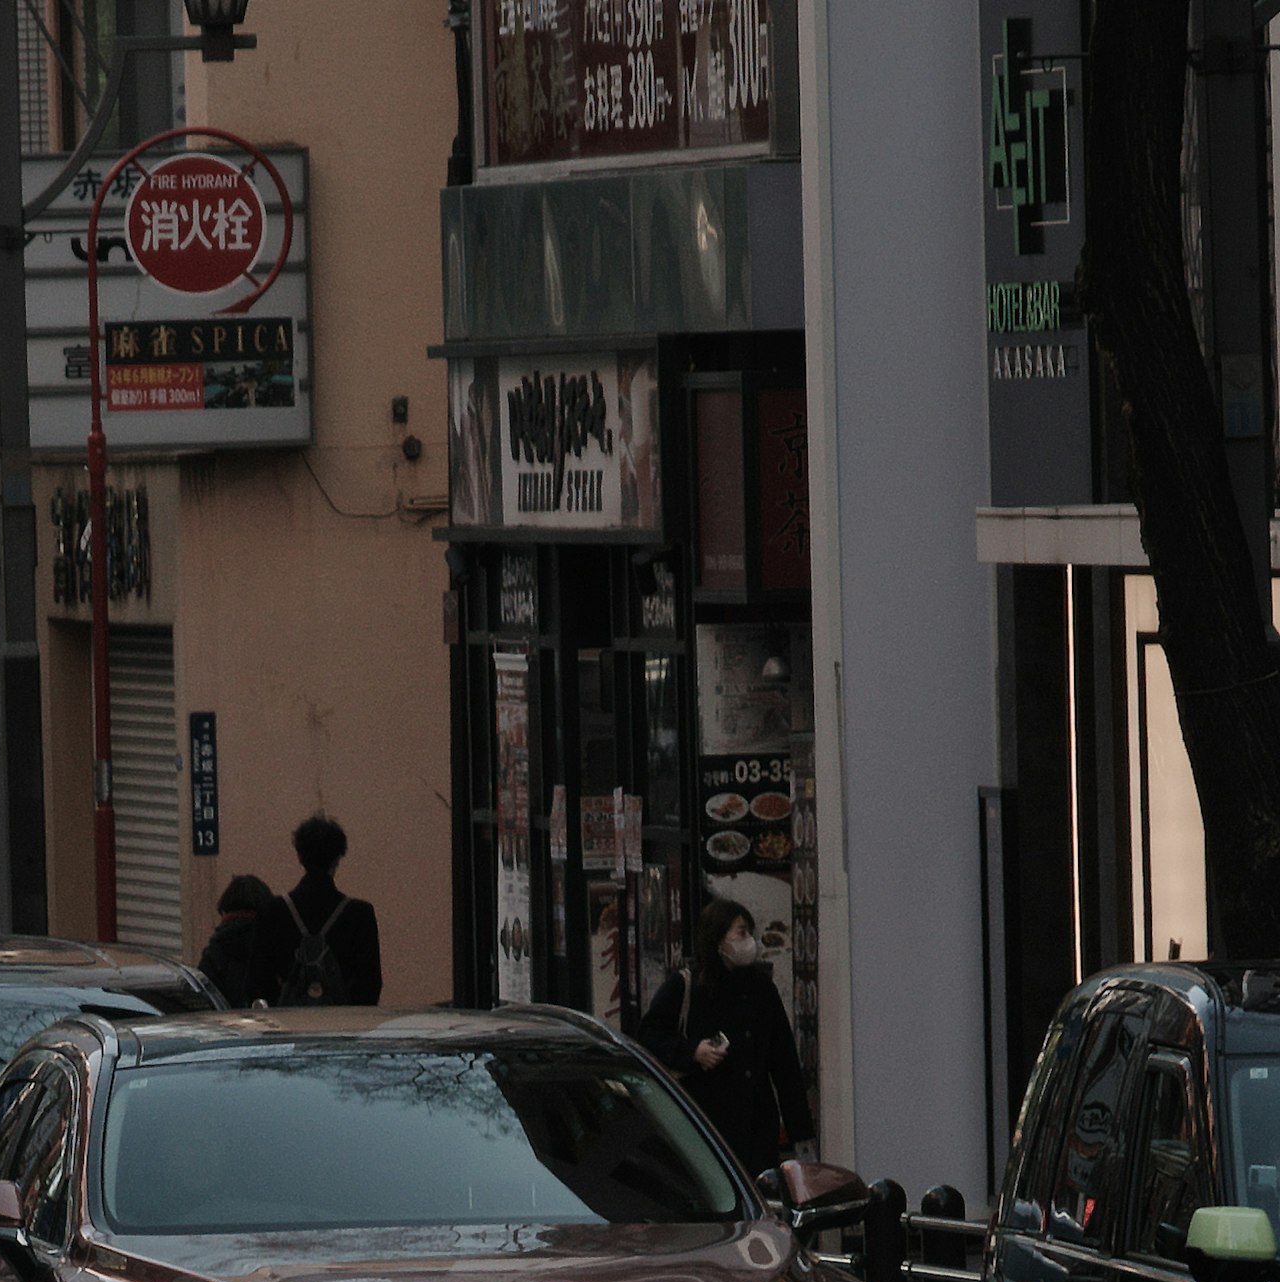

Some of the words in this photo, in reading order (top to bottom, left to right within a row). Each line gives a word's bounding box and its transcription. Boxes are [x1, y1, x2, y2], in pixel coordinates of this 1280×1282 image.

[150, 174, 177, 191] FIRE
[182, 173, 240, 190] HYDRANT
[141, 197, 253, 252] 消火栓
[111, 323, 177, 359] 麻雀
[191, 322, 289, 354] SPICA
[992, 344, 1067, 380] AKASAKA
[197, 830, 215, 847] 13
